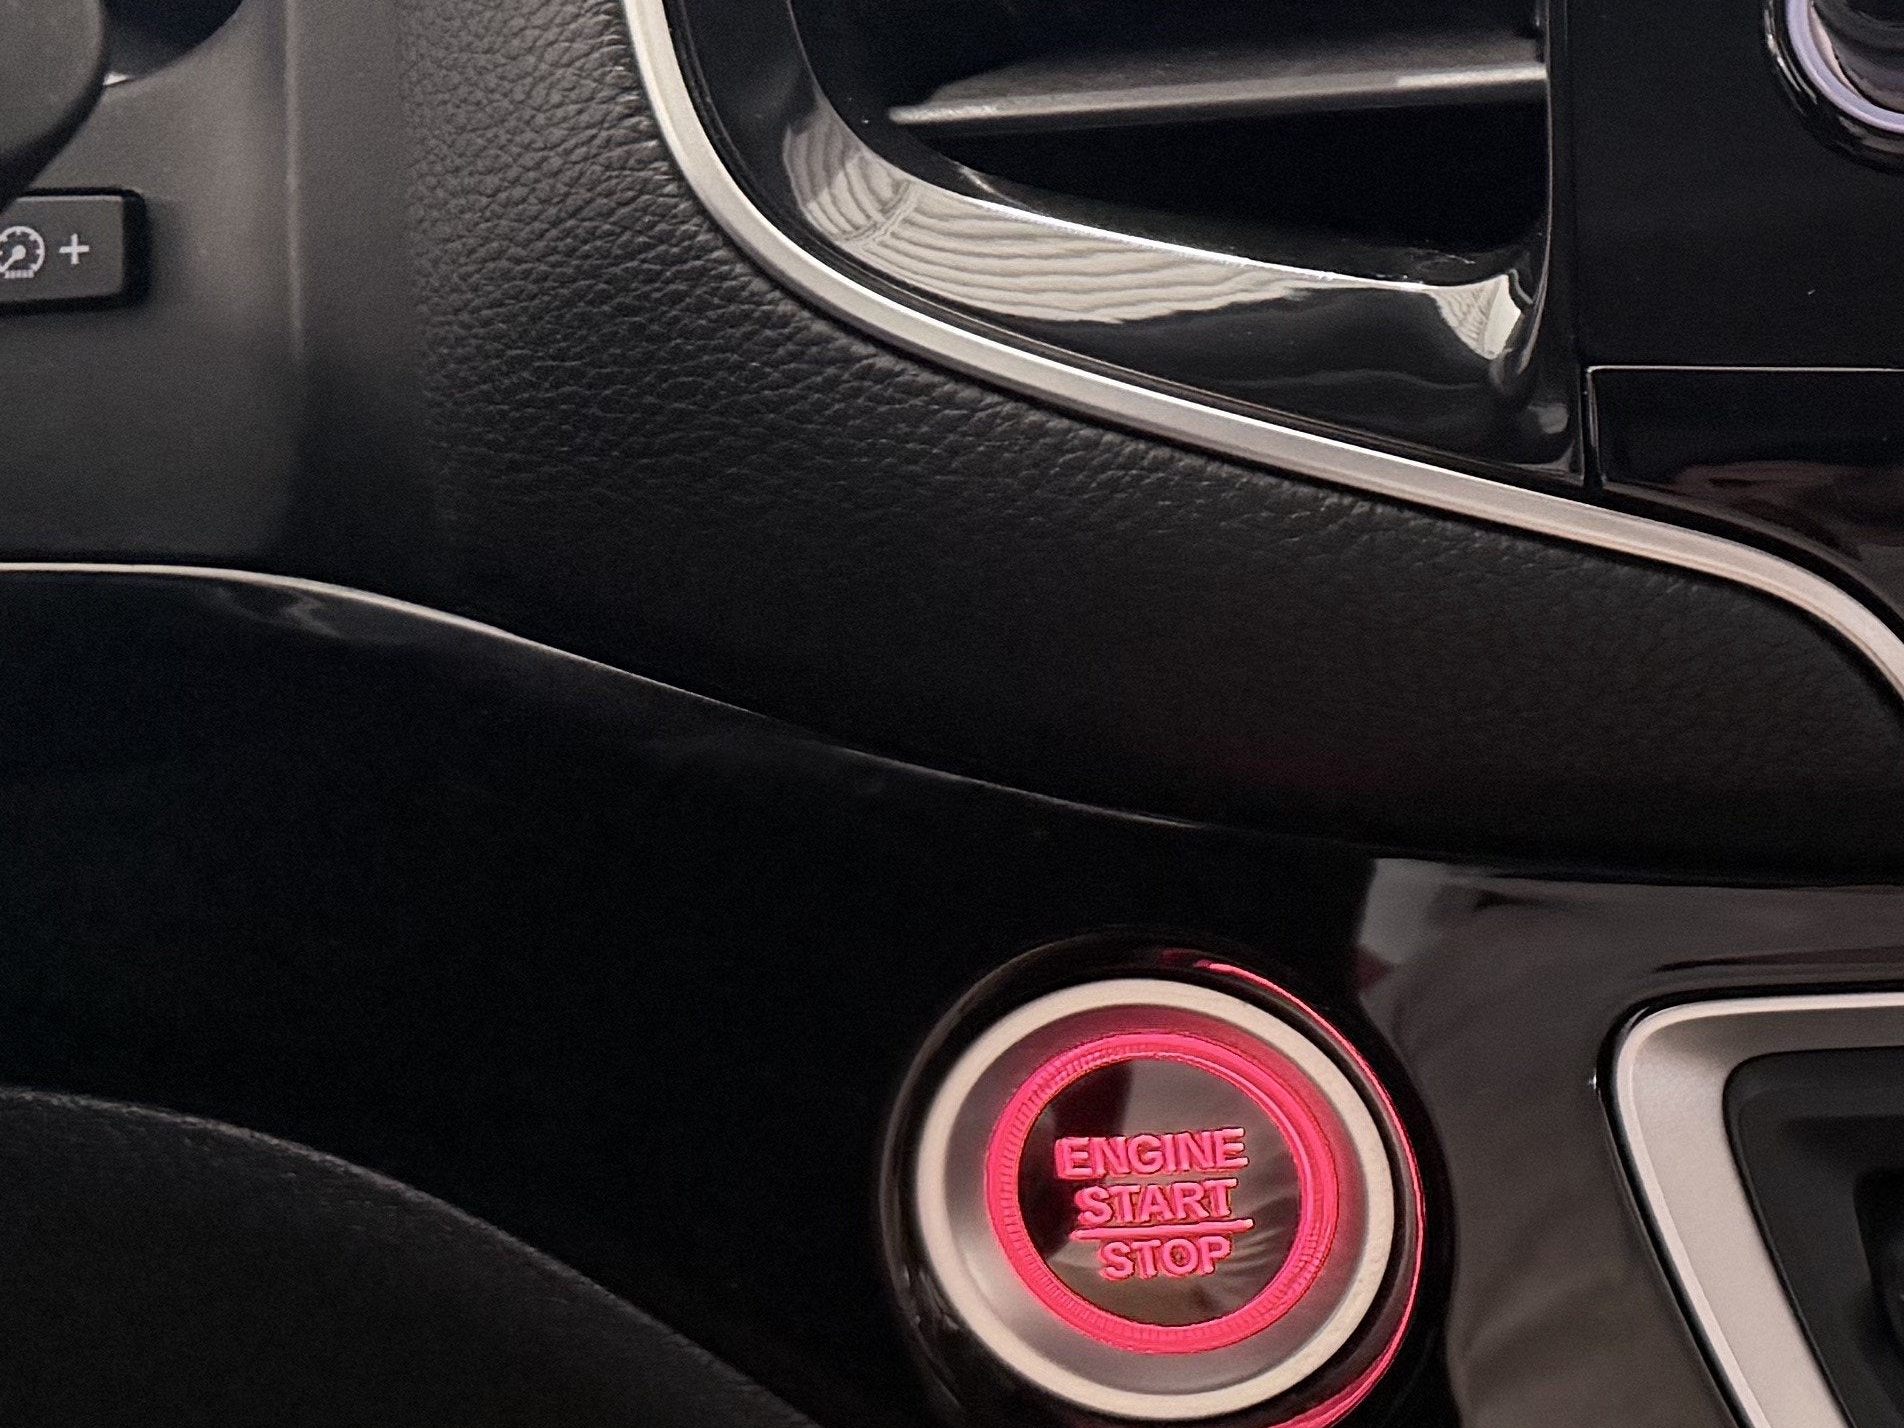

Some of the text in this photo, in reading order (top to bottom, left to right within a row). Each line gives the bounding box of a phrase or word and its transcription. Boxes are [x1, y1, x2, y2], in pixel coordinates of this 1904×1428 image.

[1055, 1128, 1249, 1179] ENGINE
[1075, 1178, 1239, 1225] START
[1099, 1235, 1233, 1279] STOP
